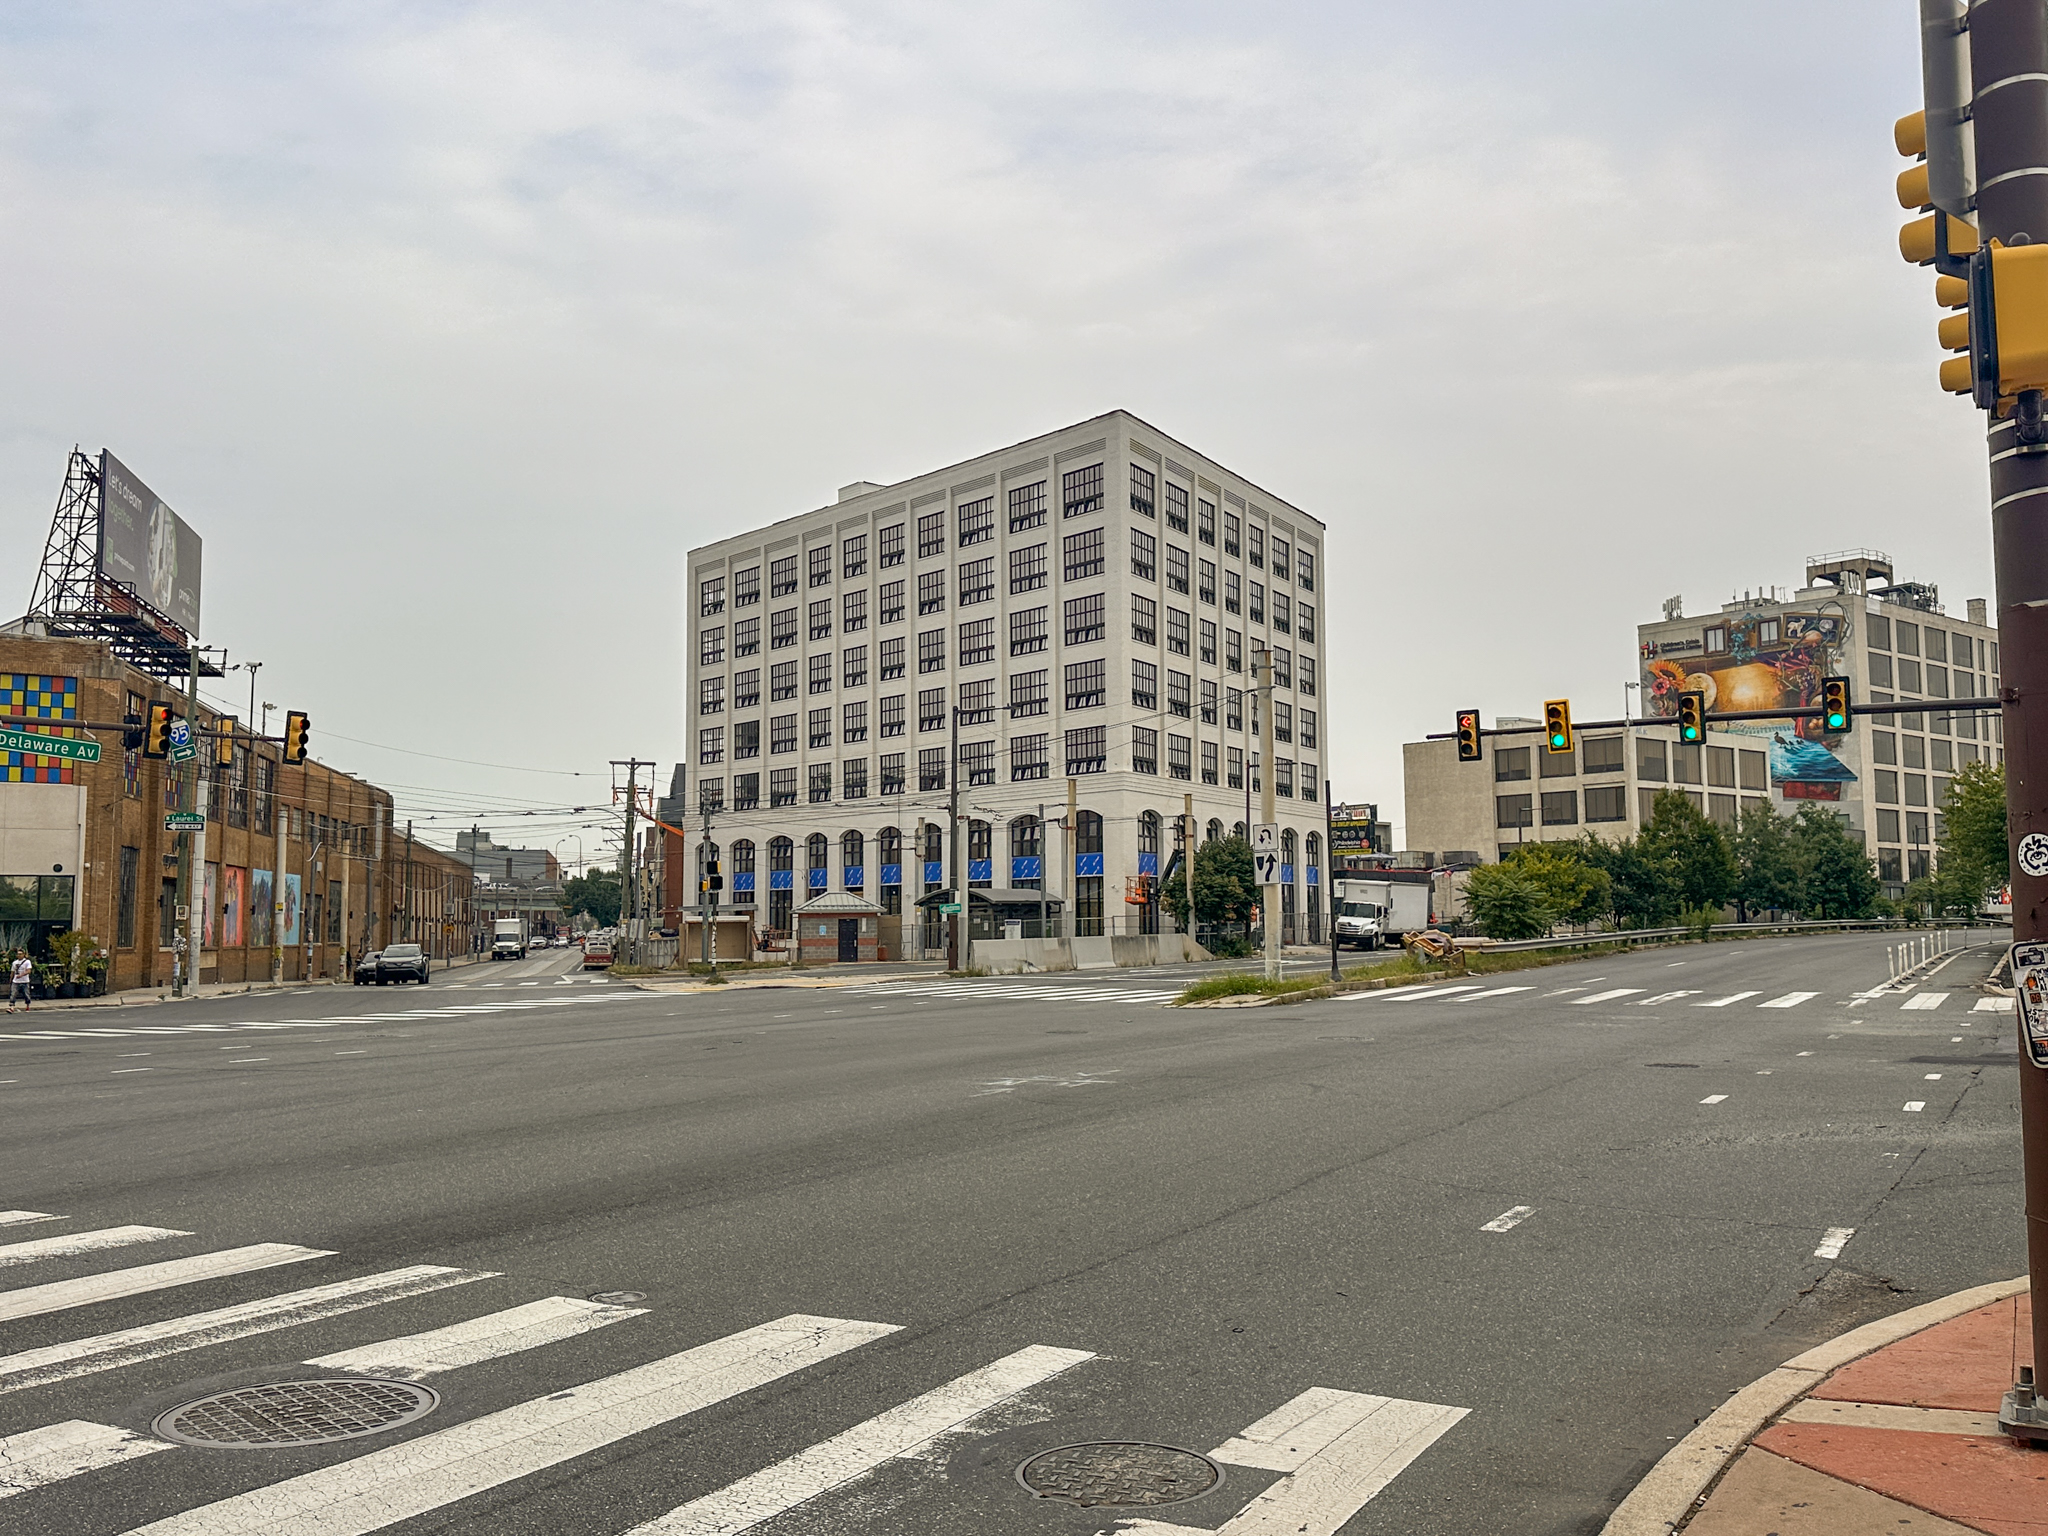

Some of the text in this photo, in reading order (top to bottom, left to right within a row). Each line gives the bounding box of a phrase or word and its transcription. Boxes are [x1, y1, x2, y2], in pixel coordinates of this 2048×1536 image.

[108, 468, 143, 513] Let's dream
[0, 733, 95, 758] Delaware Av
[171, 726, 189, 742] 95
